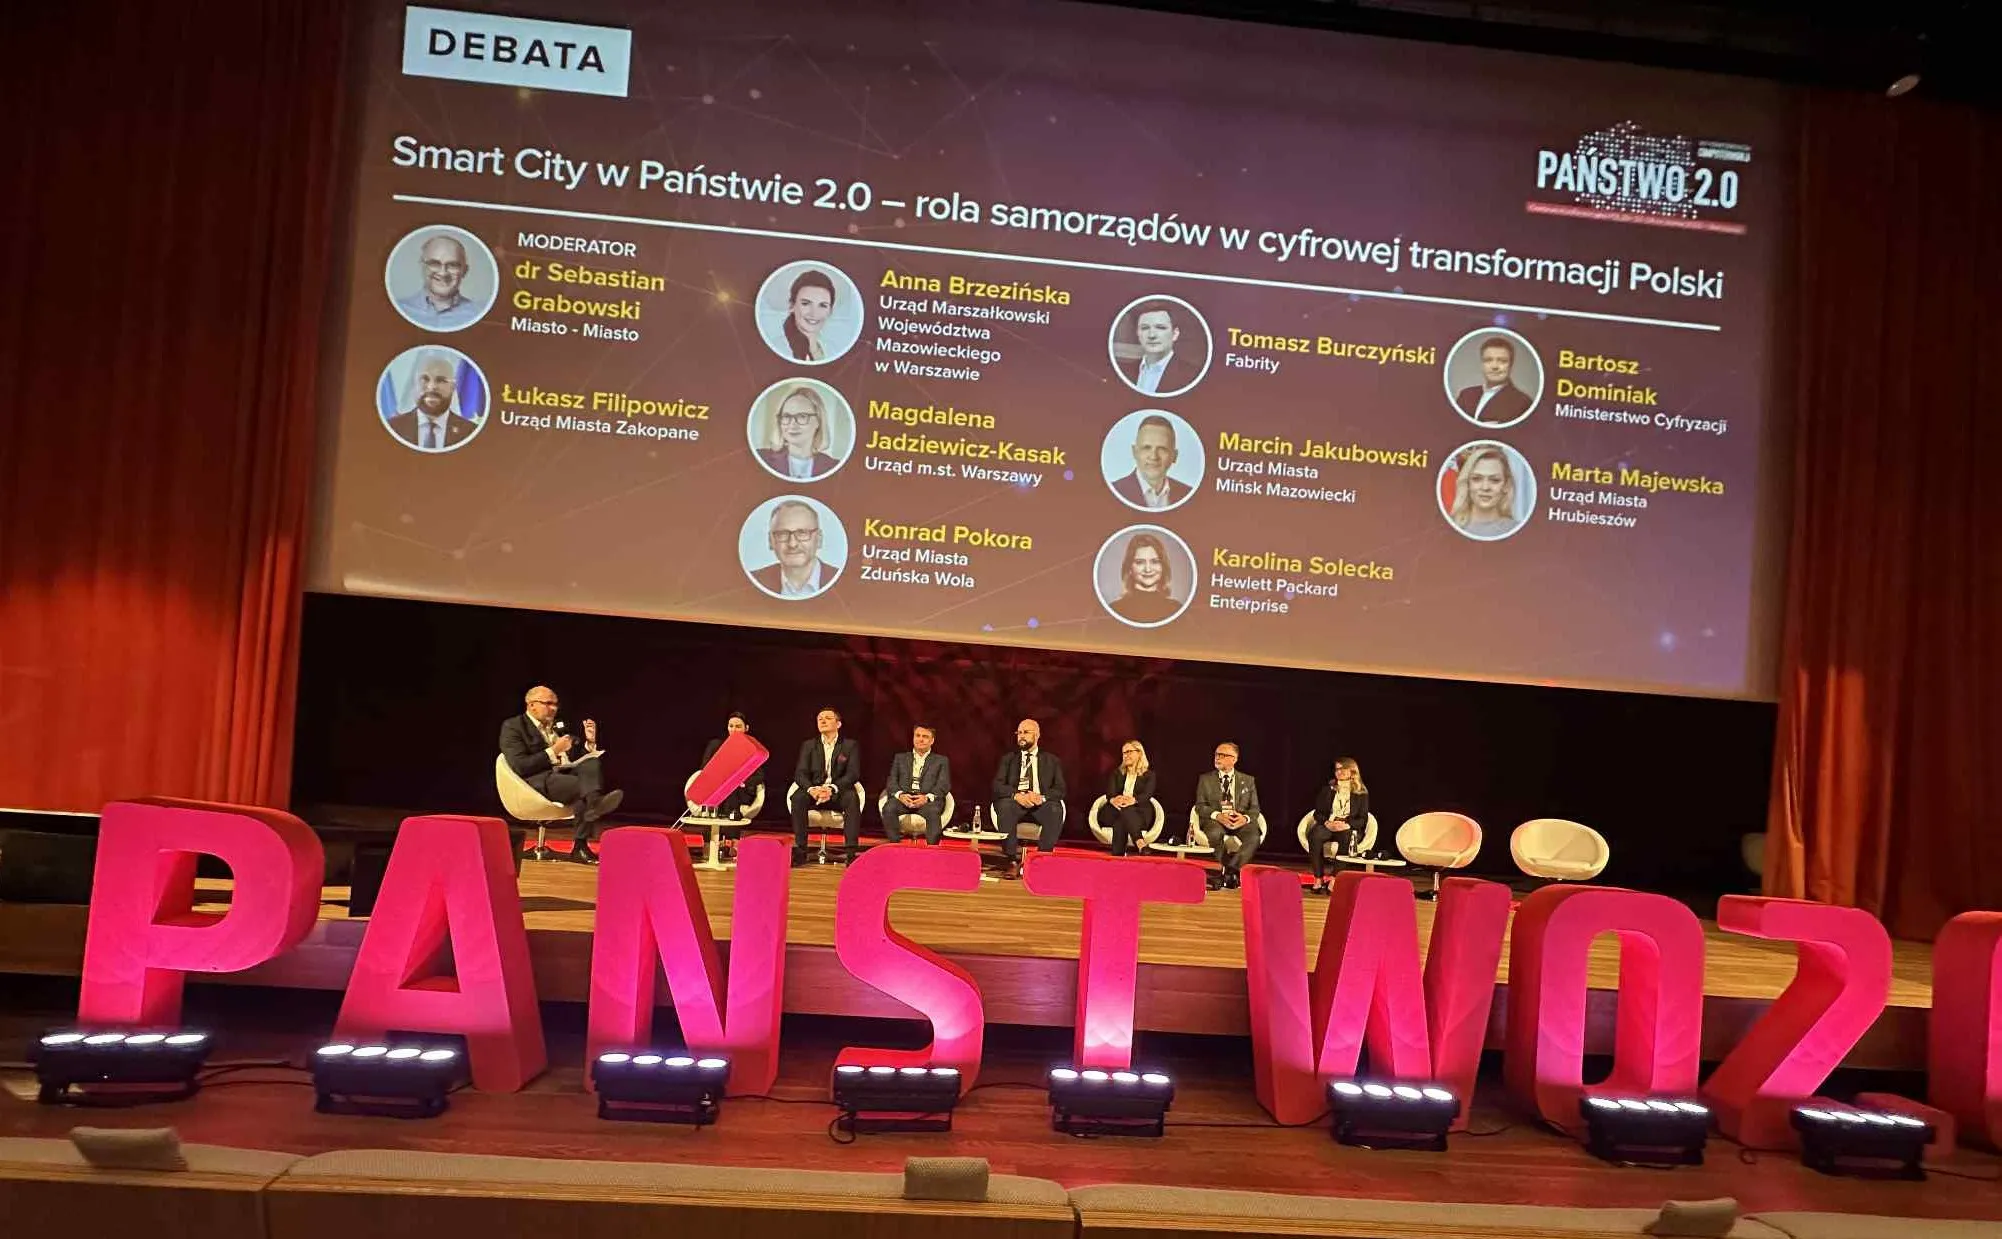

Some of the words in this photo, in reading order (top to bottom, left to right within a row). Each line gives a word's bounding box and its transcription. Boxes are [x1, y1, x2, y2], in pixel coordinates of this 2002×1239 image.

[427, 27, 606, 73] DEBATA
[1536, 146, 1686, 202] PAŃSTWO
[1693, 167, 1739, 209] 2.0
[391, 135, 505, 176] Smart
[514, 147, 589, 191] City
[596, 162, 631, 188] w
[639, 159, 804, 205] Państwie
[812, 177, 872, 212] 2.0
[915, 191, 980, 224] rola
[989, 203, 1212, 247] samorządów
[1219, 226, 1251, 251] w
[1258, 227, 1401, 273] cyfrowej
[1408, 240, 1621, 295] transformacji
[1629, 261, 1725, 300] Polski
[517, 231, 637, 258] MODERATOR
[514, 260, 542, 280] dr
[547, 262, 665, 292] Sebastian
[879, 269, 942, 293] Anna
[948, 275, 1071, 306] Brzezińska
[512, 290, 641, 320] Grabowski
[879, 294, 928, 316] Urząd
[931, 299, 1050, 325] Marszałkowski
[510, 316, 568, 335] Miasto
[582, 322, 640, 342] Miasto
[877, 315, 991, 340] Województwa
[876, 336, 1002, 365] Mazowieckiego
[1227, 327, 1311, 353] Tomasz
[1316, 336, 1436, 365] Burczyński
[874, 361, 890, 373] w
[893, 359, 981, 381] Warszawie
[1225, 352, 1281, 375] Fabrity
[1558, 349, 1640, 375] Bartosz
[501, 383, 586, 409] Łukasz
[592, 391, 710, 420] Filipowicz
[1556, 378, 1658, 406] Dominiak
[500, 410, 551, 431] Urząd
[555, 415, 611, 433] Miasta
[615, 420, 700, 441] Zakopane
[868, 400, 996, 429] Magdalena
[1554, 403, 1651, 426] Ministerstwo
[1653, 412, 1728, 436] Cyfryzacji
[865, 430, 1066, 465] Jadziewicz-Kasak
[1219, 431, 1293, 457] Marcin
[1299, 439, 1429, 468] Jakubowski
[864, 455, 913, 476] Urząd
[916, 463, 956, 477] m.st.
[961, 464, 1043, 488] Warszawy
[1217, 456, 1264, 477] Urząd
[1267, 461, 1319, 479] Miasta
[1551, 461, 1614, 485] Marta
[1619, 463, 1724, 495] Majewska
[1215, 477, 1263, 495] Mińsk
[1265, 482, 1357, 504] Mazowiecki
[1550, 486, 1595, 506] Urząd
[1598, 491, 1648, 509] Miasta
[1548, 507, 1637, 528] Hrubieszów
[864, 518, 947, 543] Konrad
[953, 525, 1033, 550] Pokora
[862, 543, 911, 564] Urząd
[915, 548, 969, 566] Miasta
[1213, 547, 1302, 573] Karolina
[1309, 556, 1394, 580] Solecka
[860, 565, 930, 585] Zduńska
[934, 571, 975, 588] Wola
[1210, 573, 1273, 592] Hewlett
[1276, 578, 1338, 597] Packard
[1209, 594, 1289, 614] Enterprise
